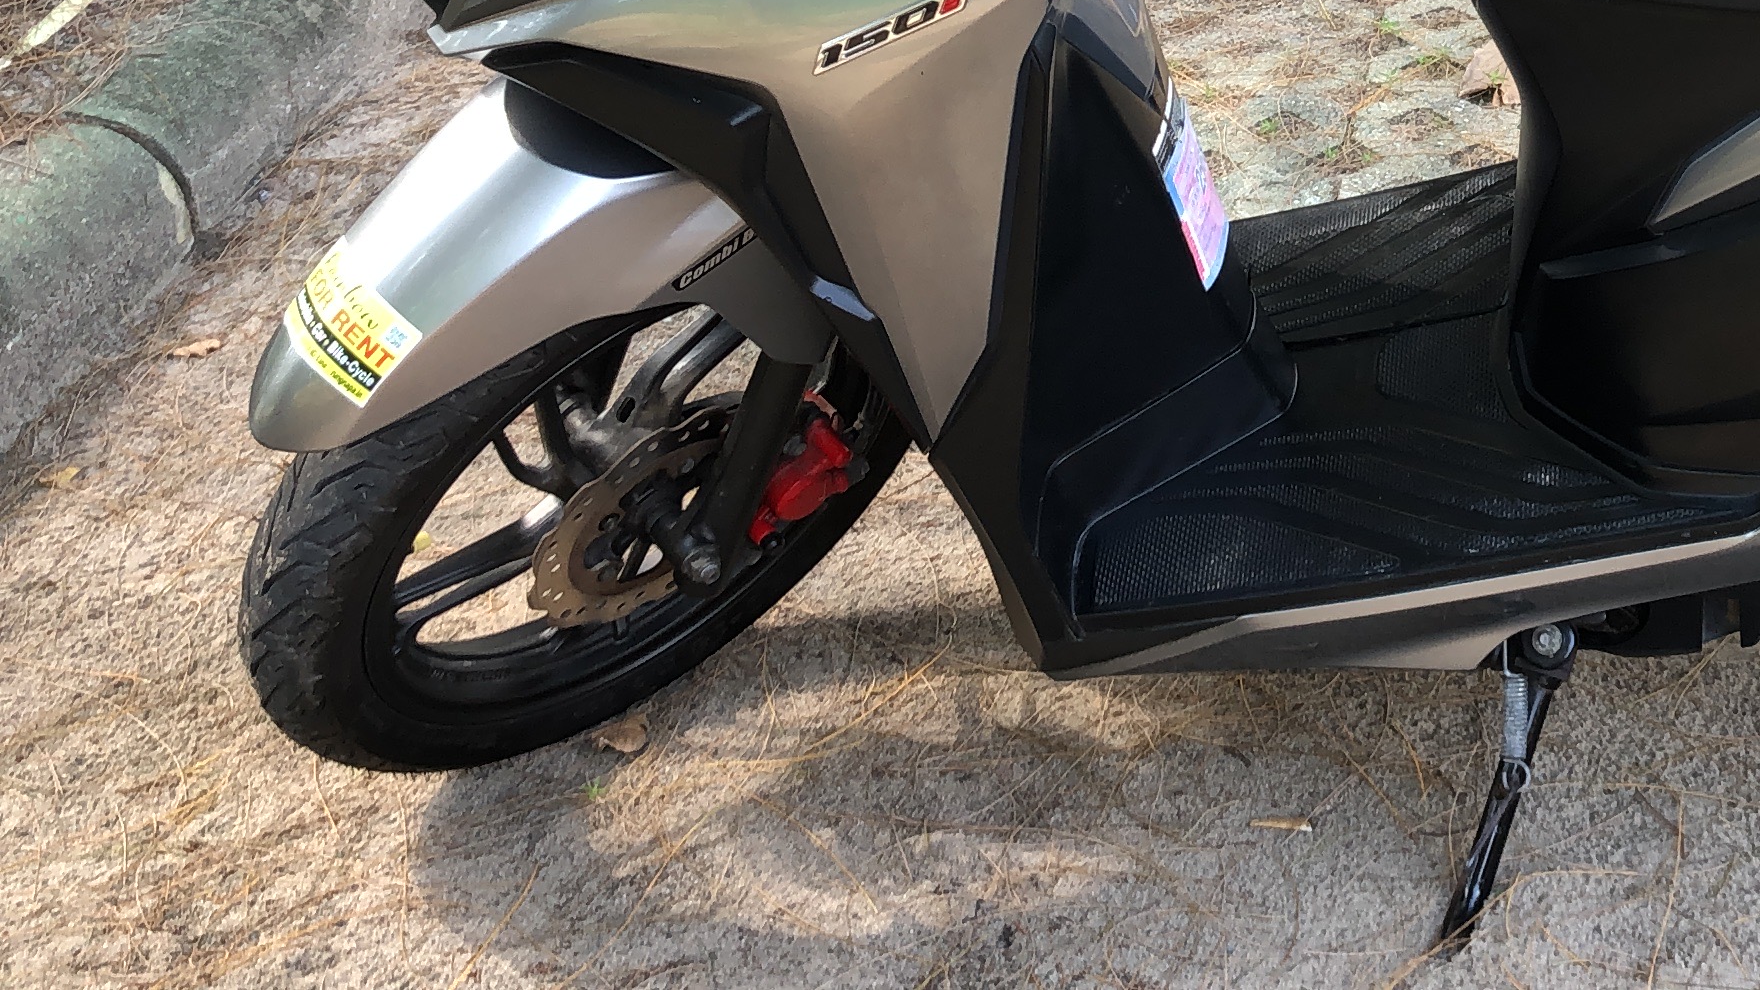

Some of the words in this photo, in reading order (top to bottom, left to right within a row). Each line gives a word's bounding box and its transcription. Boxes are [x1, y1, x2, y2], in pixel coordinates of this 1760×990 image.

[325, 252, 379, 330] ainbow
[679, 236, 740, 289] Combi
[310, 268, 335, 311] FOR
[331, 308, 396, 369] RENT
